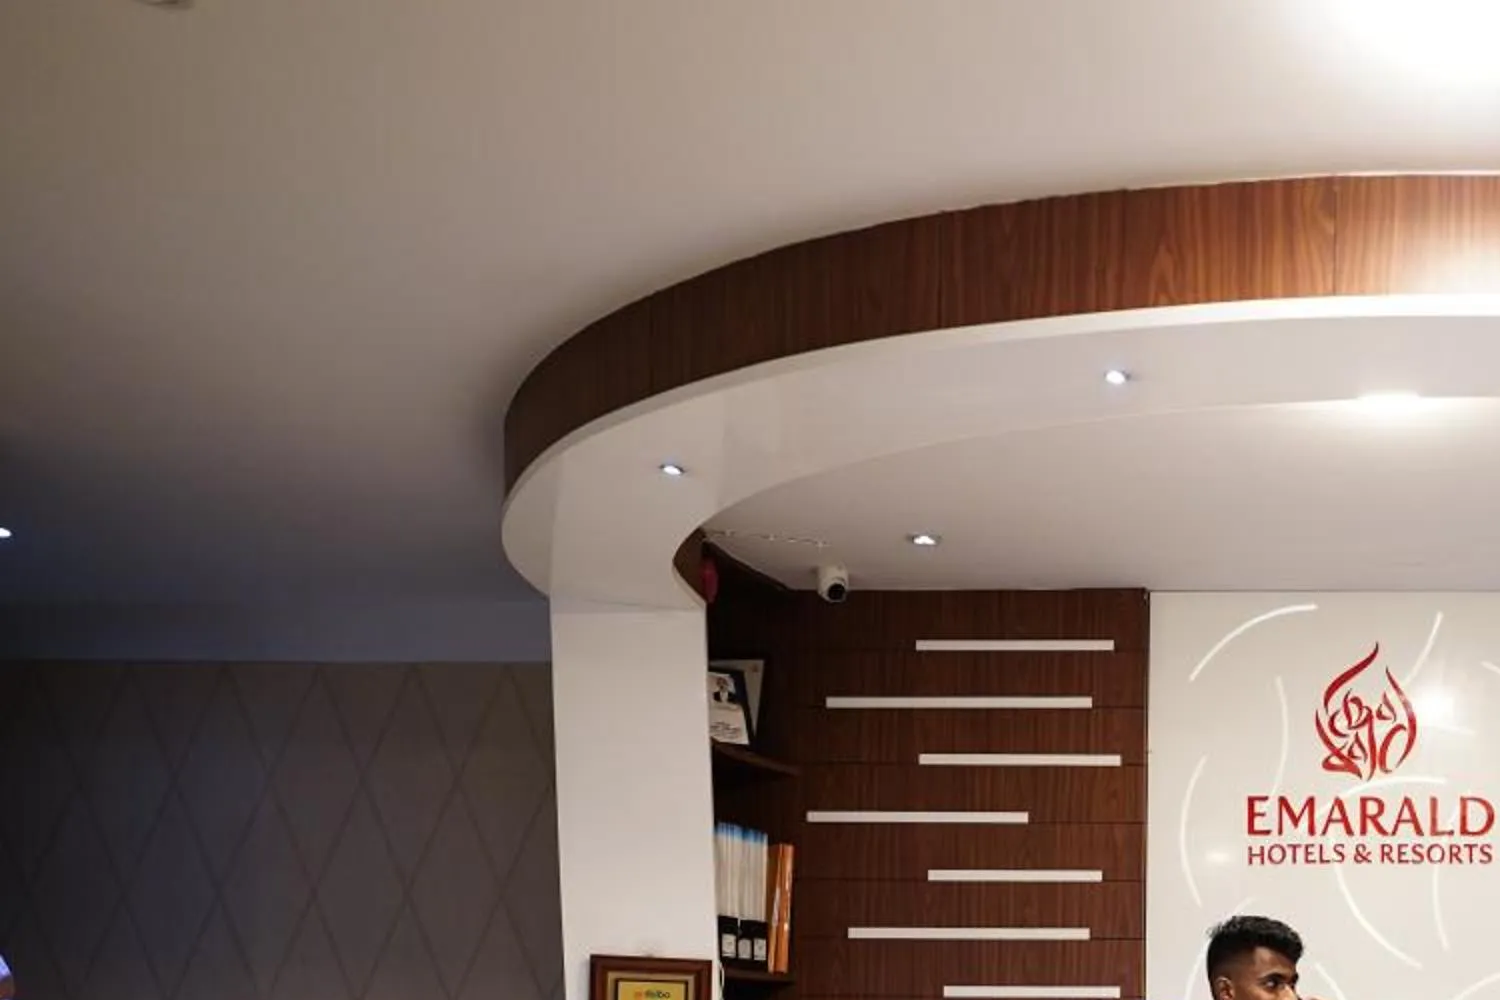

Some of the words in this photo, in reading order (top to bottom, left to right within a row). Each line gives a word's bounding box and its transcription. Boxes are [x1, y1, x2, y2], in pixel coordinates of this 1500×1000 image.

[1246, 795, 1496, 836] EMARALD
[1247, 843, 1346, 865] HOTELS
[1353, 843, 1373, 864] &
[1379, 843, 1493, 865] RESORTS
